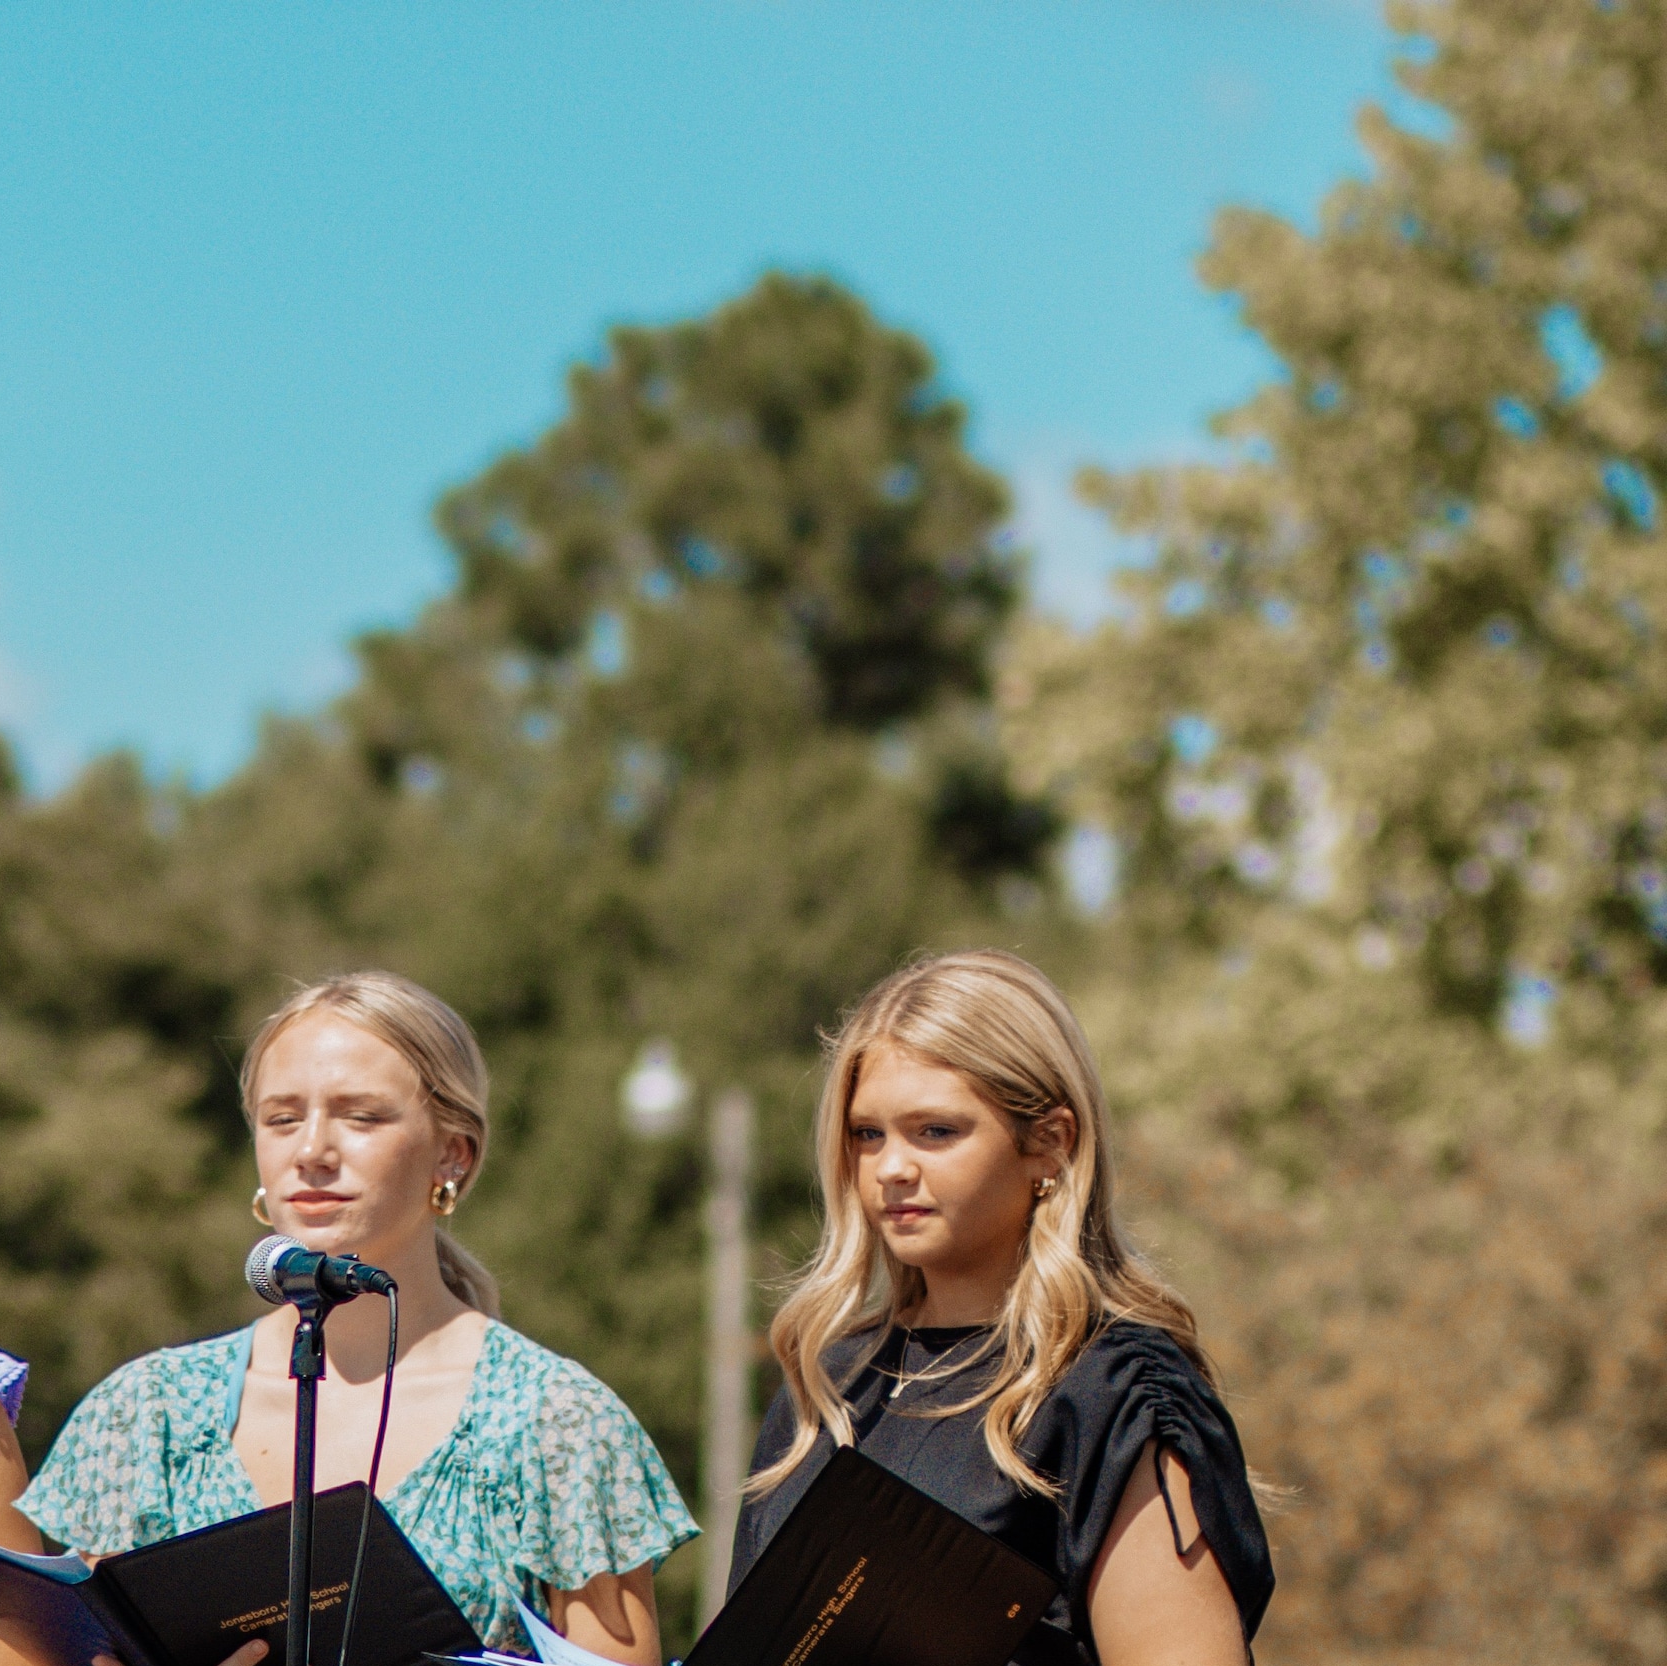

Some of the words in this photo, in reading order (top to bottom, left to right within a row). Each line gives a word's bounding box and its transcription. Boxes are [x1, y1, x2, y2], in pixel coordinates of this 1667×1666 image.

[220, 1605, 278, 1629] Jonesboro
[310, 1582, 350, 1600] School
[817, 1597, 838, 1621] High
[837, 1556, 868, 1594] School
[833, 1576, 865, 1615] Singers
[1007, 1603, 1021, 1618] 68
